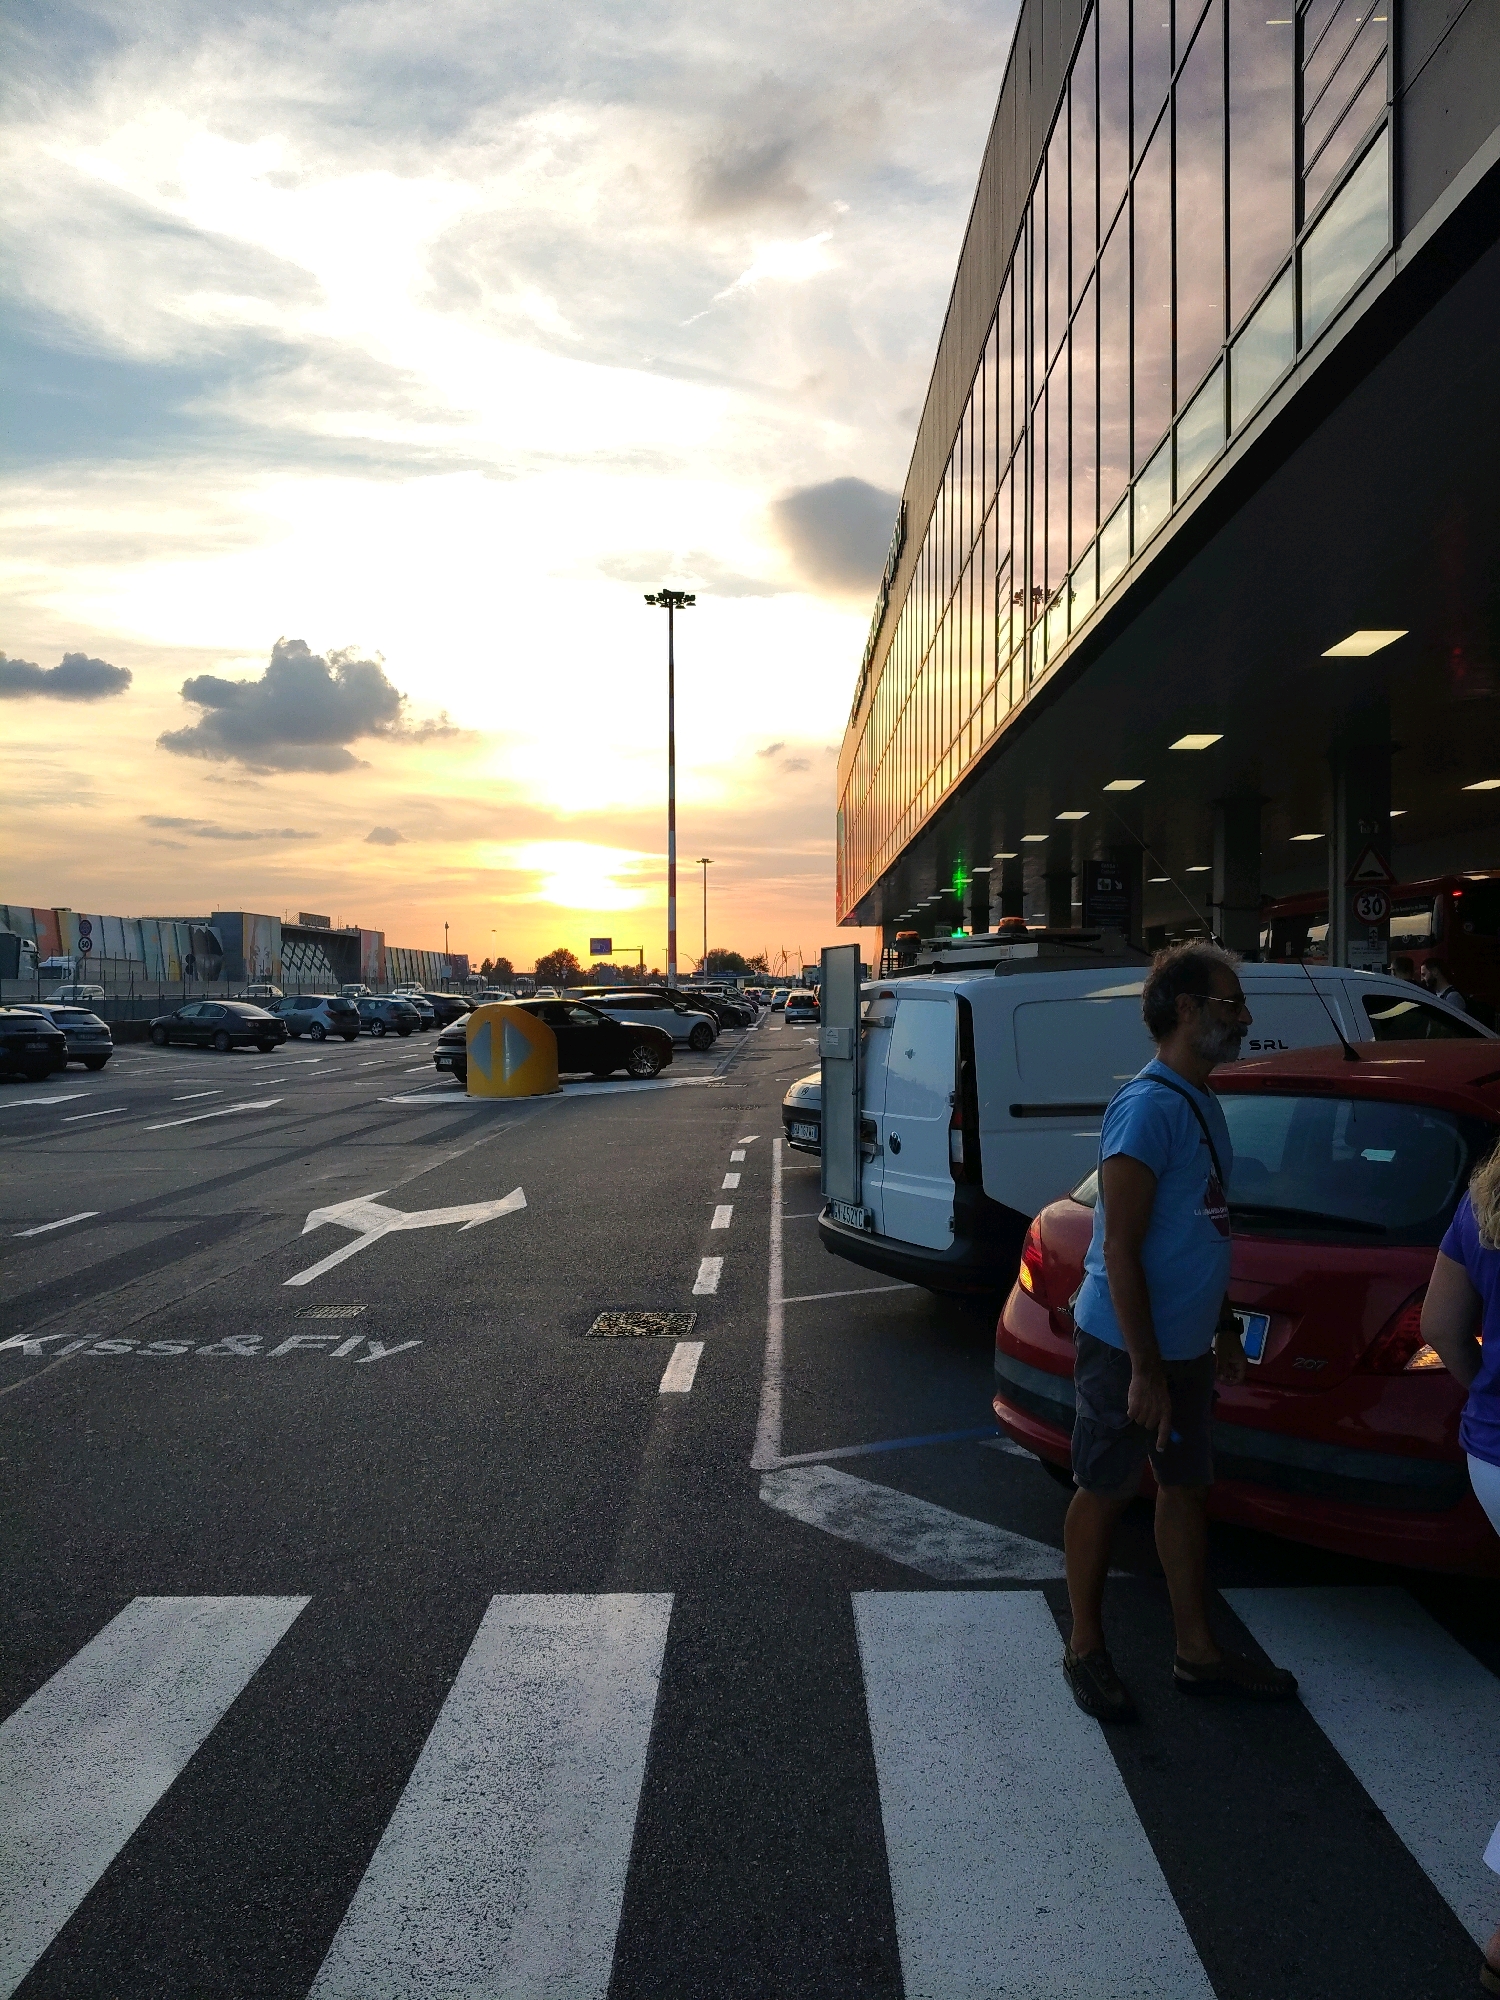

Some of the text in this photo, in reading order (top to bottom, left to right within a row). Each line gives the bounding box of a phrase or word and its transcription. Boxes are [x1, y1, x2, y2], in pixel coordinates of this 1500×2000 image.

[1361, 899, 1382, 916] 30
[82, 940, 89, 949] 50
[1249, 1039, 1289, 1051] SRL
[0, 1333, 425, 1363] Kiss&Fly
[1292, 1357, 1329, 1372] 207
